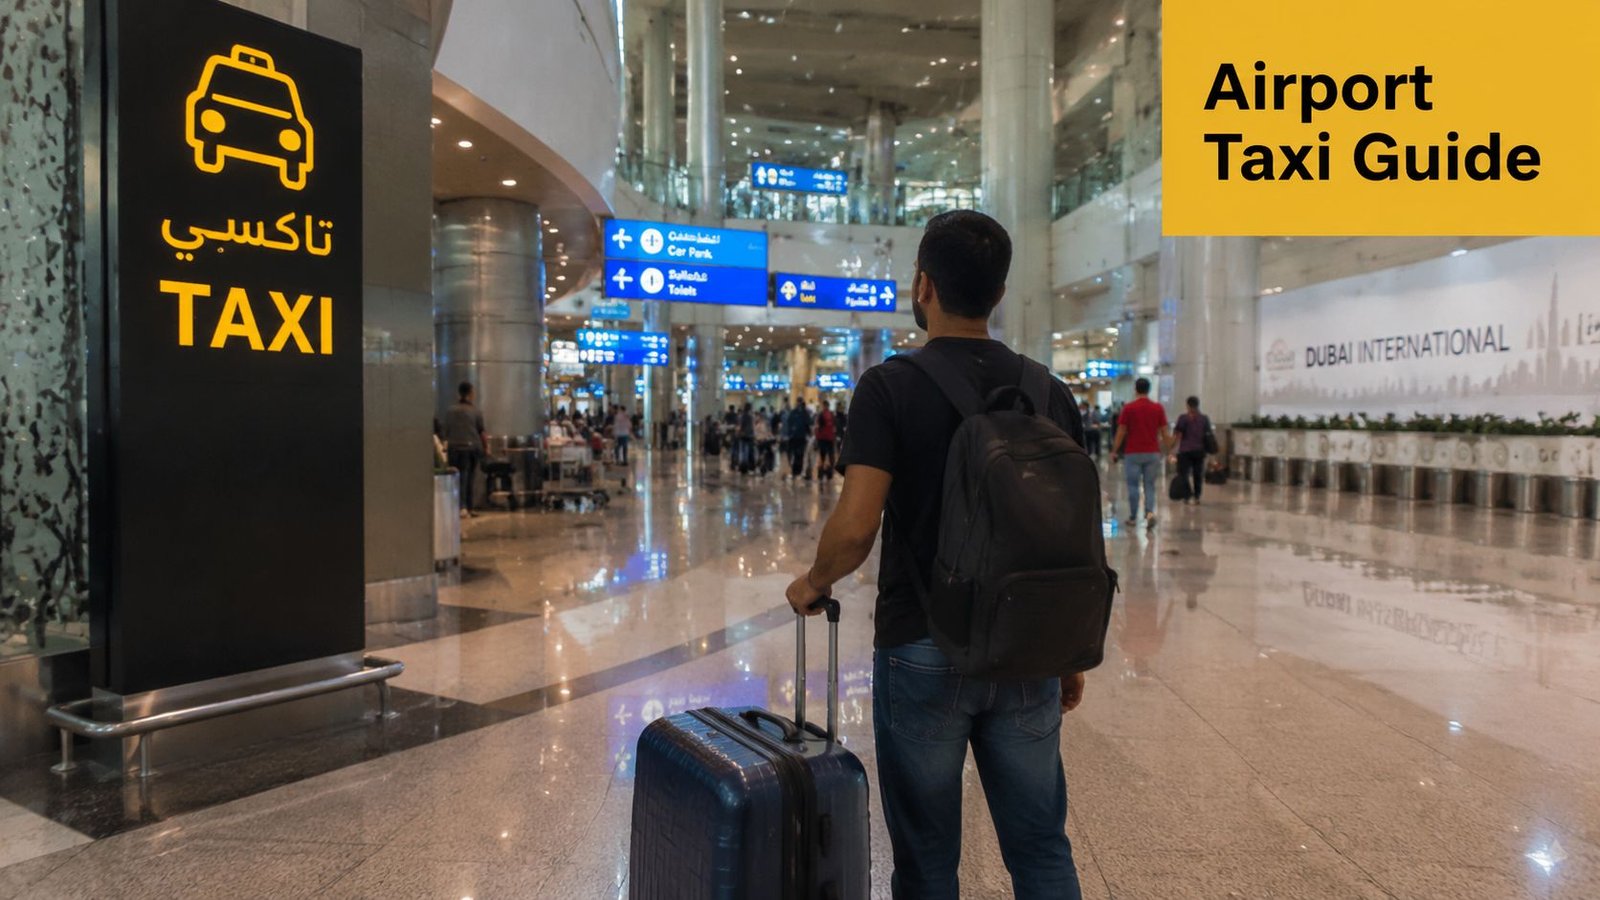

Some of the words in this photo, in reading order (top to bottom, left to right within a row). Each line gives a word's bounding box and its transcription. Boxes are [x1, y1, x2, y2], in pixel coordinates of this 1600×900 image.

[159, 279, 333, 355] TAXI
[1305, 341, 1353, 368] DUBAI
[1357, 323, 1511, 363] INTERNATIONAL
